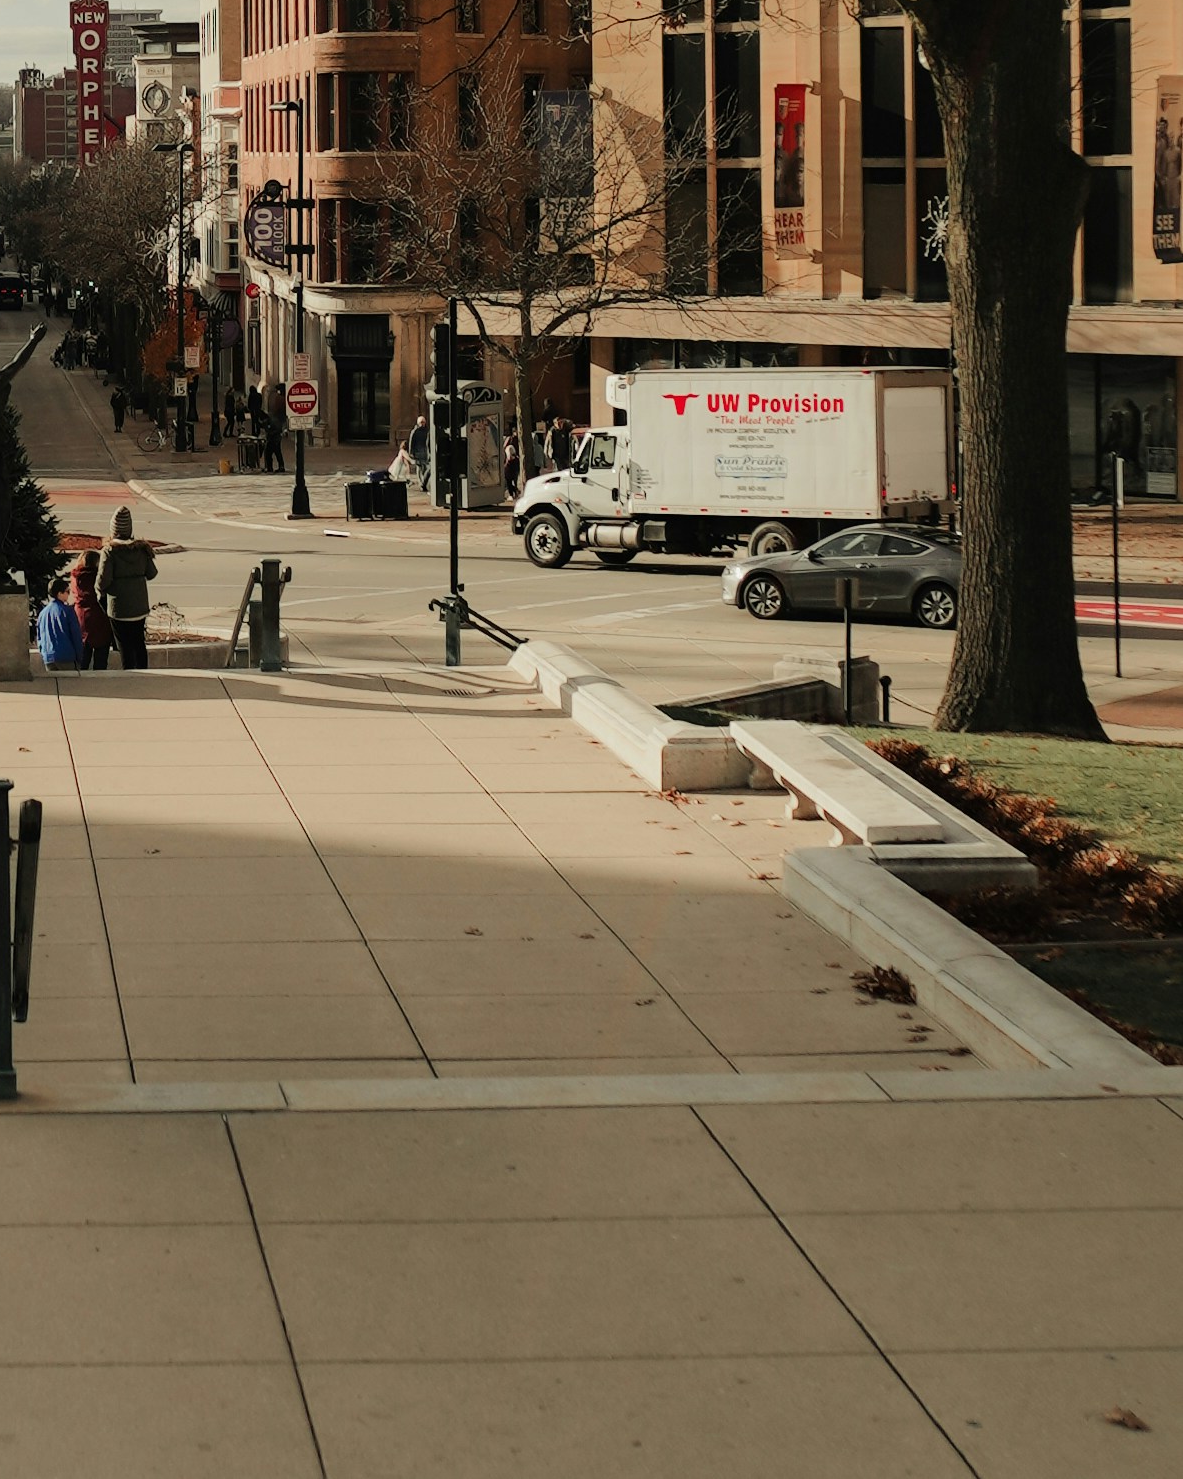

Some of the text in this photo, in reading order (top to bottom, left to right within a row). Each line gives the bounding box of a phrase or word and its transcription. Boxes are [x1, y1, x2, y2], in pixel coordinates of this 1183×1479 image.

[74, 11, 105, 24] NEW
[774, 213, 805, 228] HEAR
[1155, 214, 1175, 231] SEE
[254, 208, 273, 252] 100
[272, 215, 284, 253] BLOCK
[775, 230, 805, 246] THEM
[1153, 232, 1180, 250] THEM
[176, 386, 186, 395] 15
[707, 393, 844, 413] UW Provision
[739, 415, 762, 425] Meat
[716, 456, 786, 466] Sun Prairie
